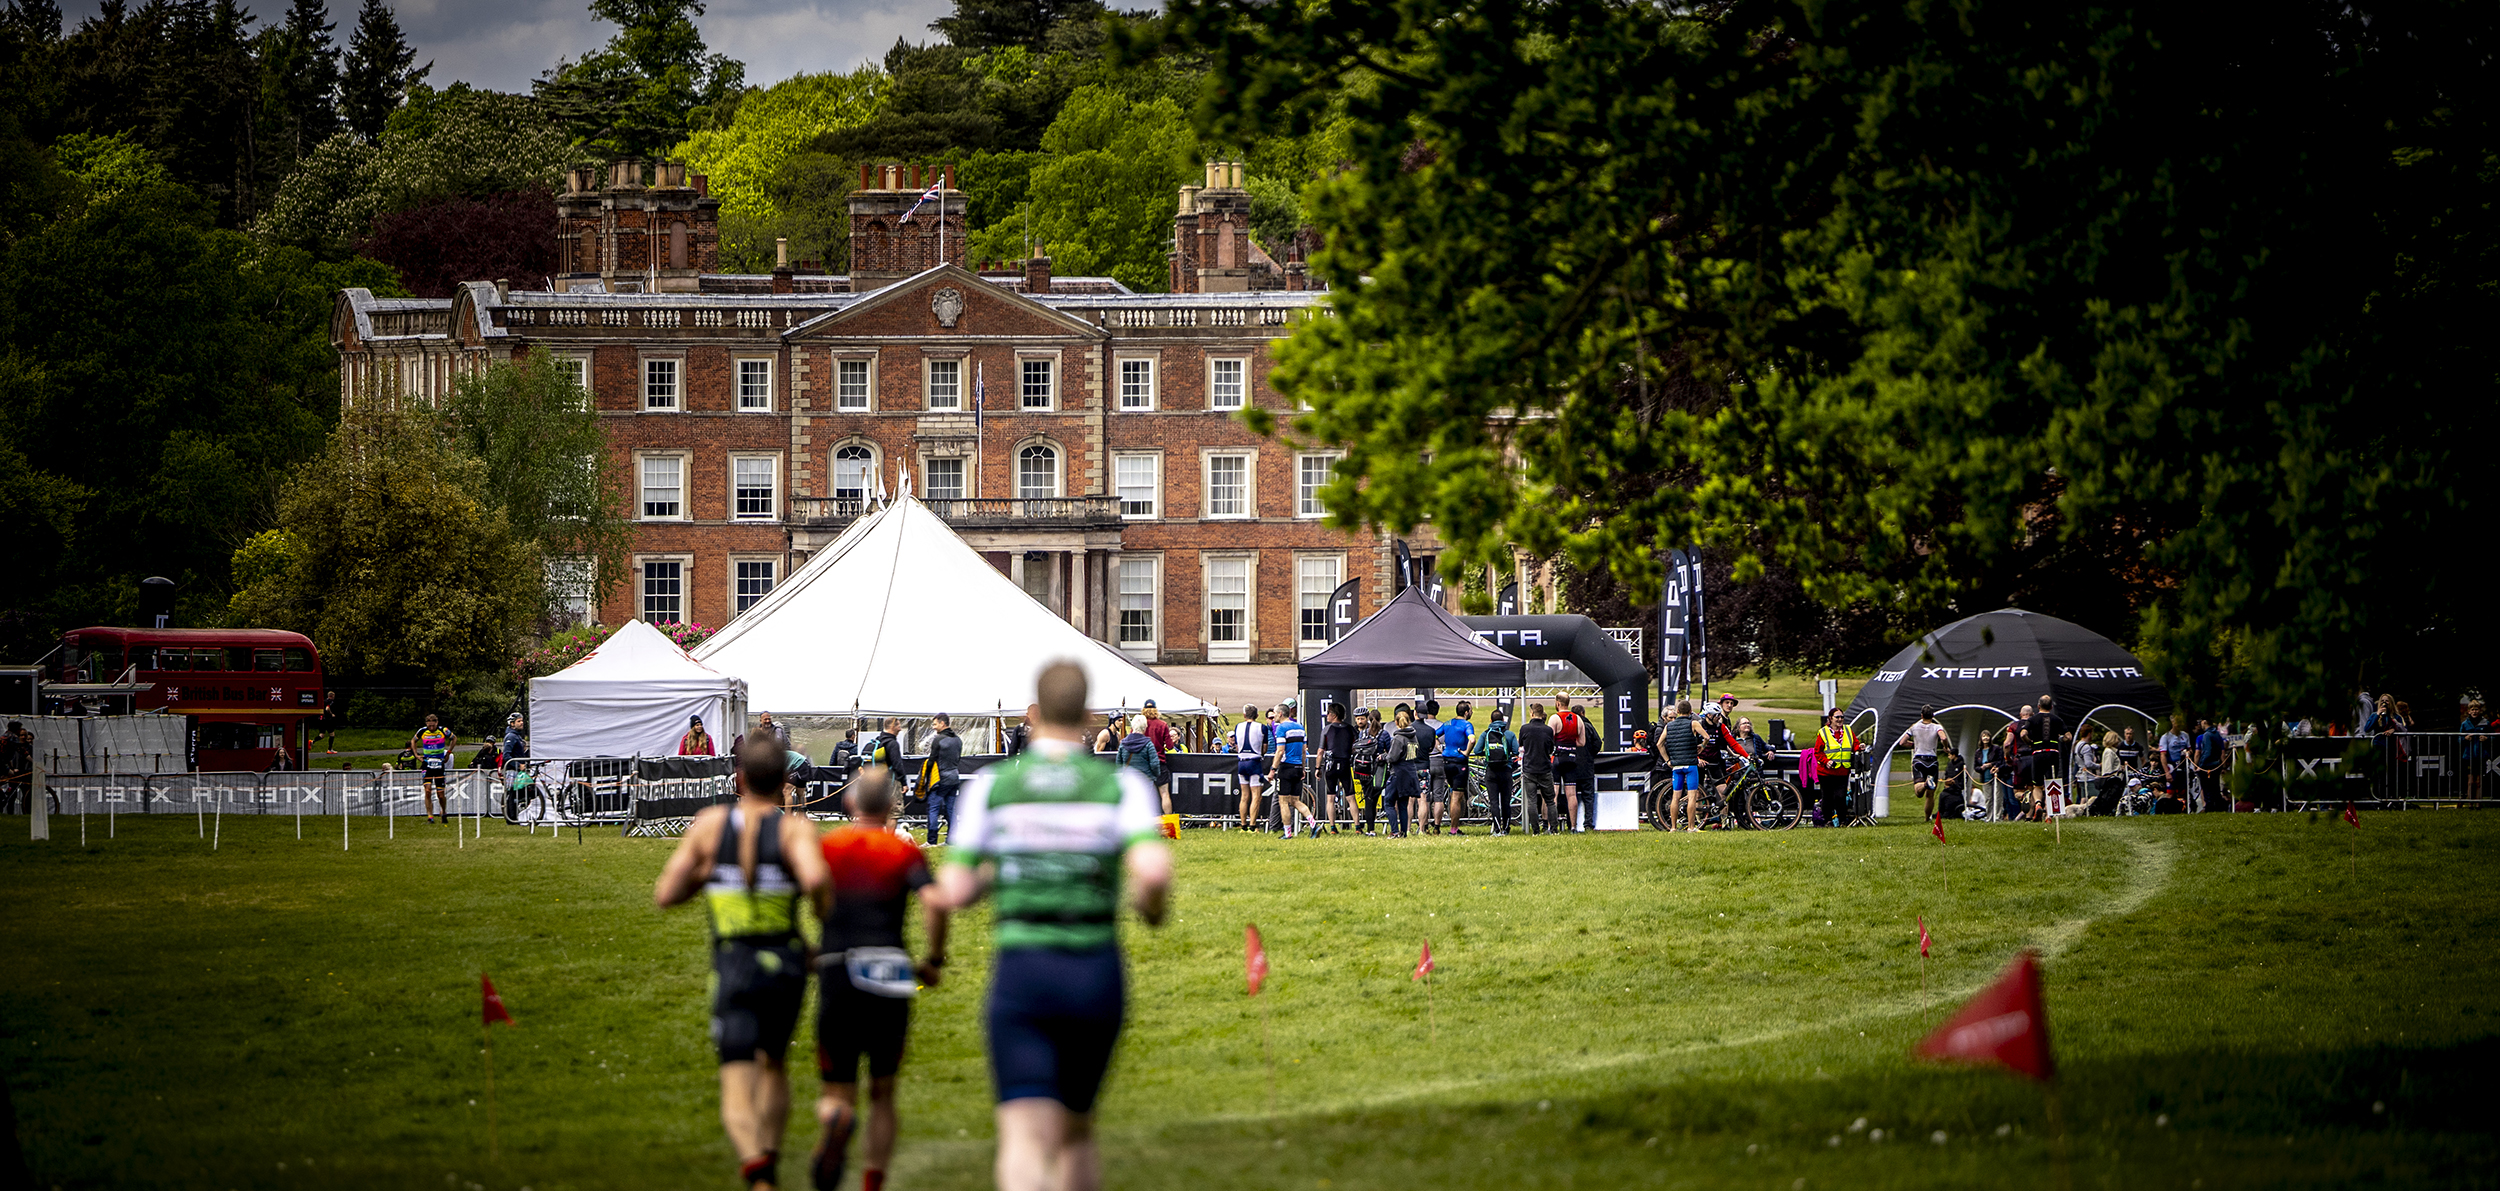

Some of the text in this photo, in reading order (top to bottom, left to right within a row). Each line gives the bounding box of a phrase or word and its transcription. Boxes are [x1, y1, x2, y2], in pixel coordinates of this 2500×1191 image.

[181, 686, 268, 701] British Bus Bar
